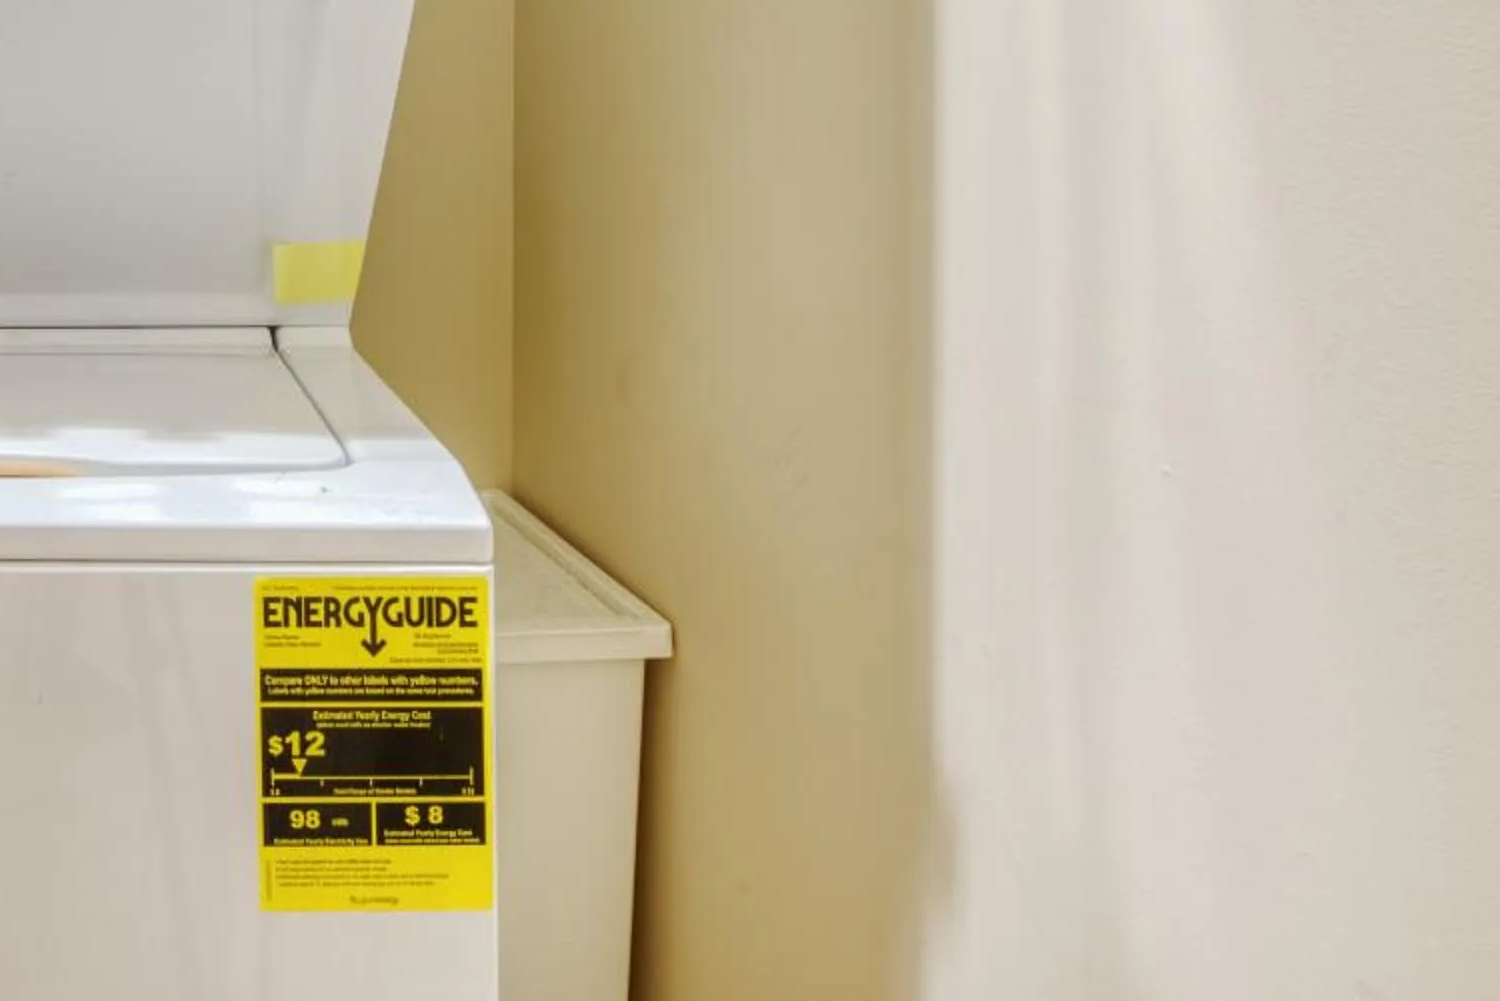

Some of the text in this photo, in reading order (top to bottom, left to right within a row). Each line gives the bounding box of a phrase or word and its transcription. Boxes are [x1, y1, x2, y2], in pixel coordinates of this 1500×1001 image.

[263, 597, 478, 641] ENERGYGUIDE
[265, 675, 302, 688] Compare
[305, 675, 327, 685] ONLY
[340, 675, 361, 685] other
[391, 675, 408, 685] with
[410, 675, 436, 687] yellow
[313, 711, 353, 720] Estimated
[354, 711, 380, 722] Yearly
[381, 711, 410, 722] Energy
[268, 731, 326, 757] $12
[289, 810, 321, 829] 98
[405, 805, 443, 826] $ 8
